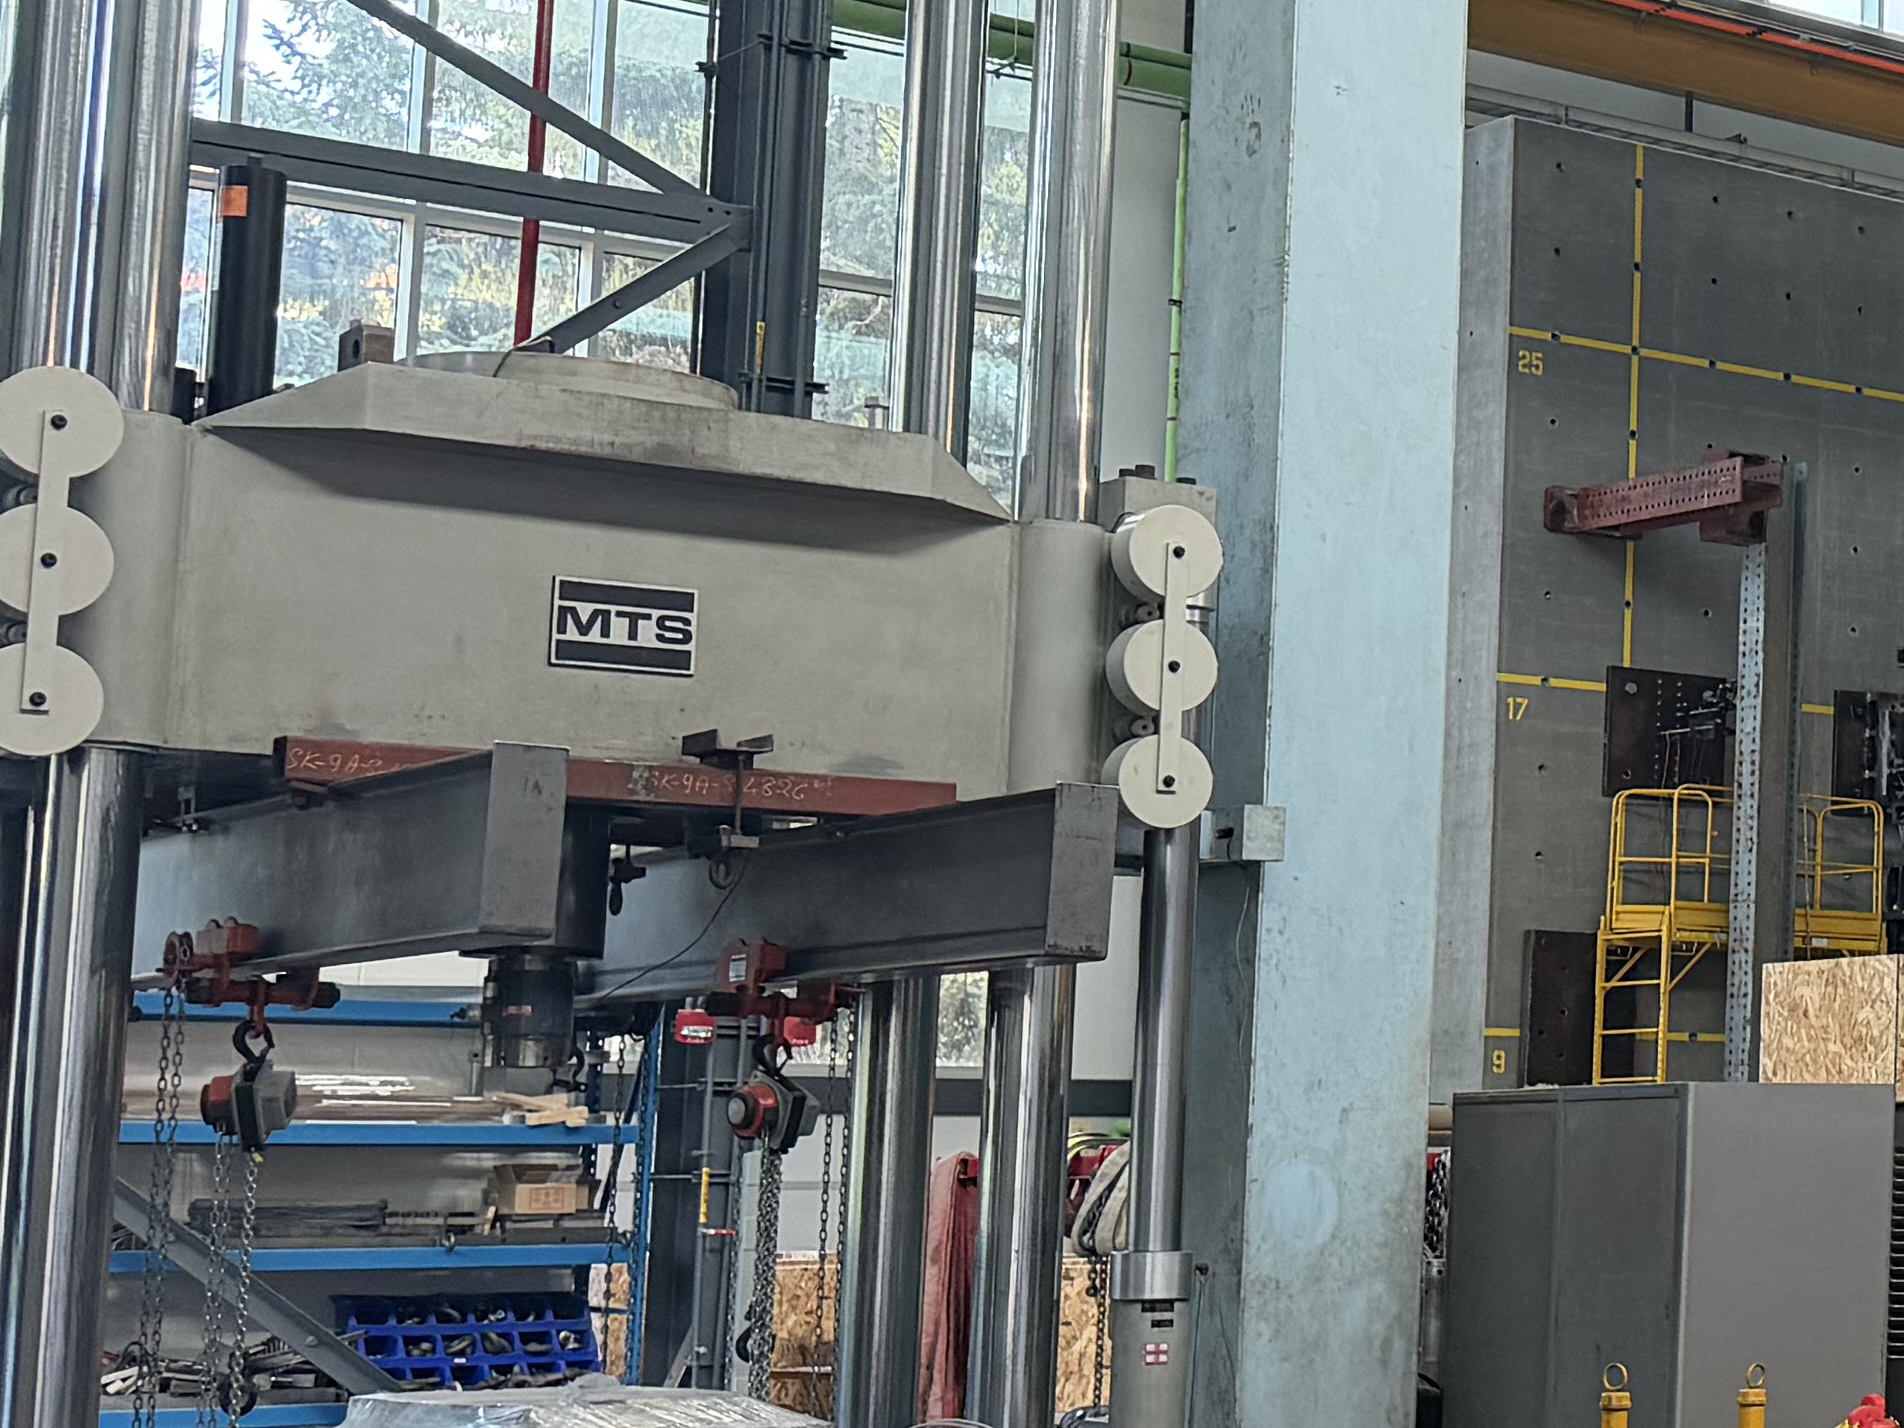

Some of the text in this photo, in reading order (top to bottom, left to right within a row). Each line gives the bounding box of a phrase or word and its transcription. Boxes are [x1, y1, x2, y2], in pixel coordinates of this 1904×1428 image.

[1518, 350, 1544, 376] 25
[556, 604, 694, 647] MTS
[1507, 696, 1529, 720] 17
[1492, 1049, 1506, 1074] 9
